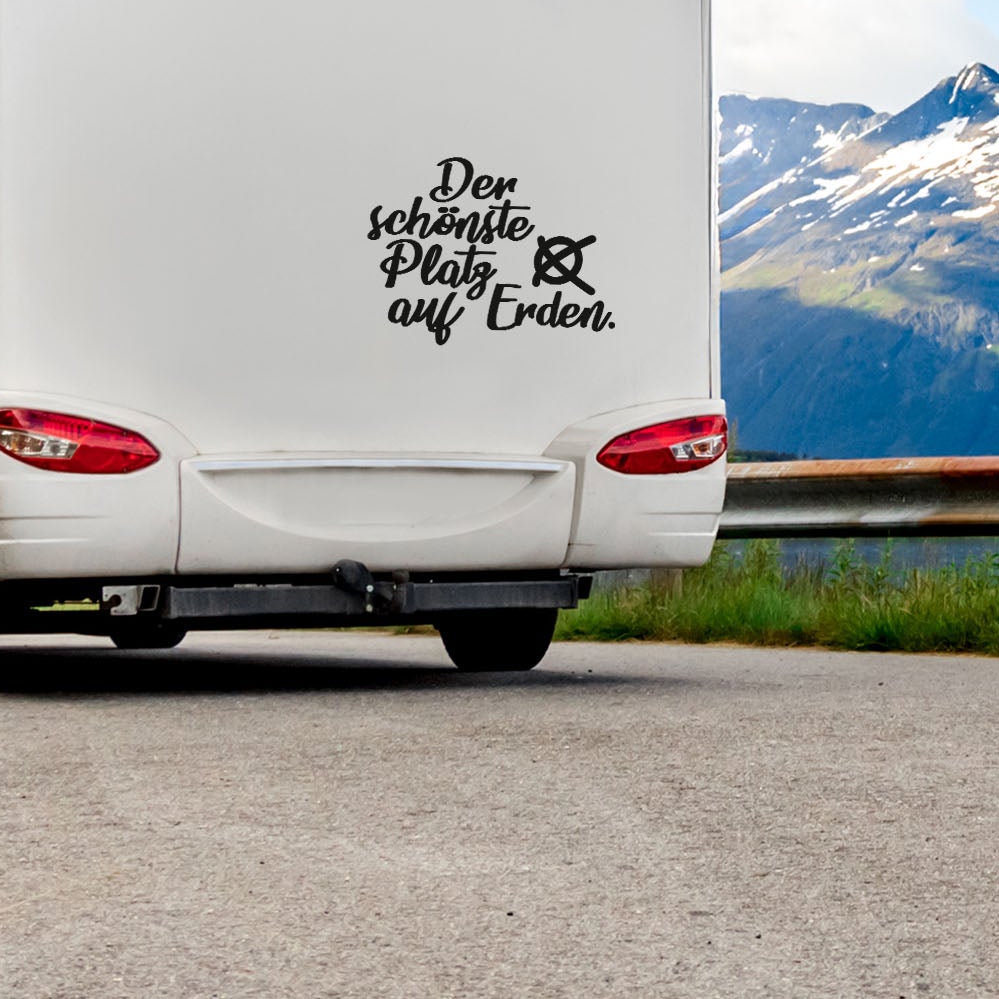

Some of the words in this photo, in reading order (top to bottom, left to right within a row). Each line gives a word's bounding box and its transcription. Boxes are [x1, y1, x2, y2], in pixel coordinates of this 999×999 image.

[429, 157, 518, 203] Der
[367, 196, 535, 245] schönste
[380, 239, 498, 300] Platz
[387, 292, 465, 345] auf
[487, 283, 616, 332] Erden.
